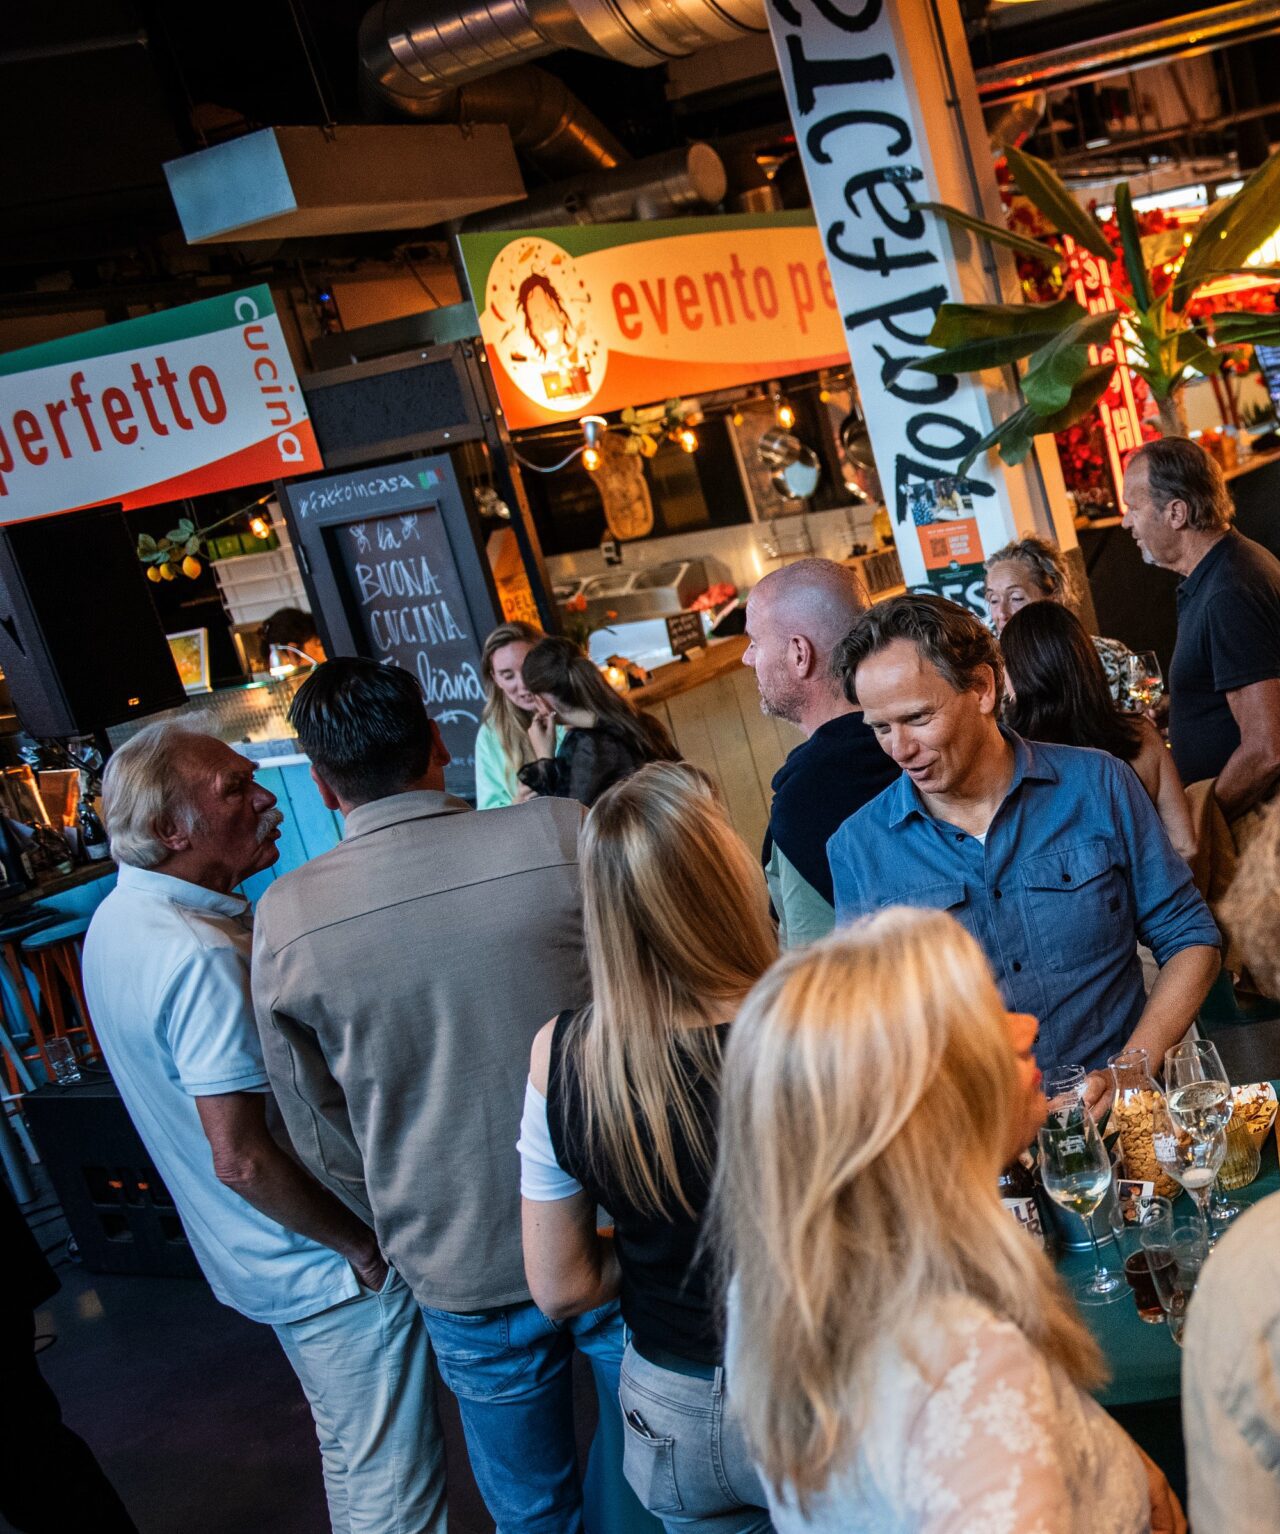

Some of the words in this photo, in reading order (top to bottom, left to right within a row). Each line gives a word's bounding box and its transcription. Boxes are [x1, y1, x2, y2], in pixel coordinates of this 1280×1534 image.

[611, 253, 779, 340] evento
[234, 296, 304, 462] cucina
[376, 520, 402, 551] la
[355, 556, 442, 605] BUONA
[370, 600, 468, 651] CUCINA
[379, 651, 488, 705] liana
